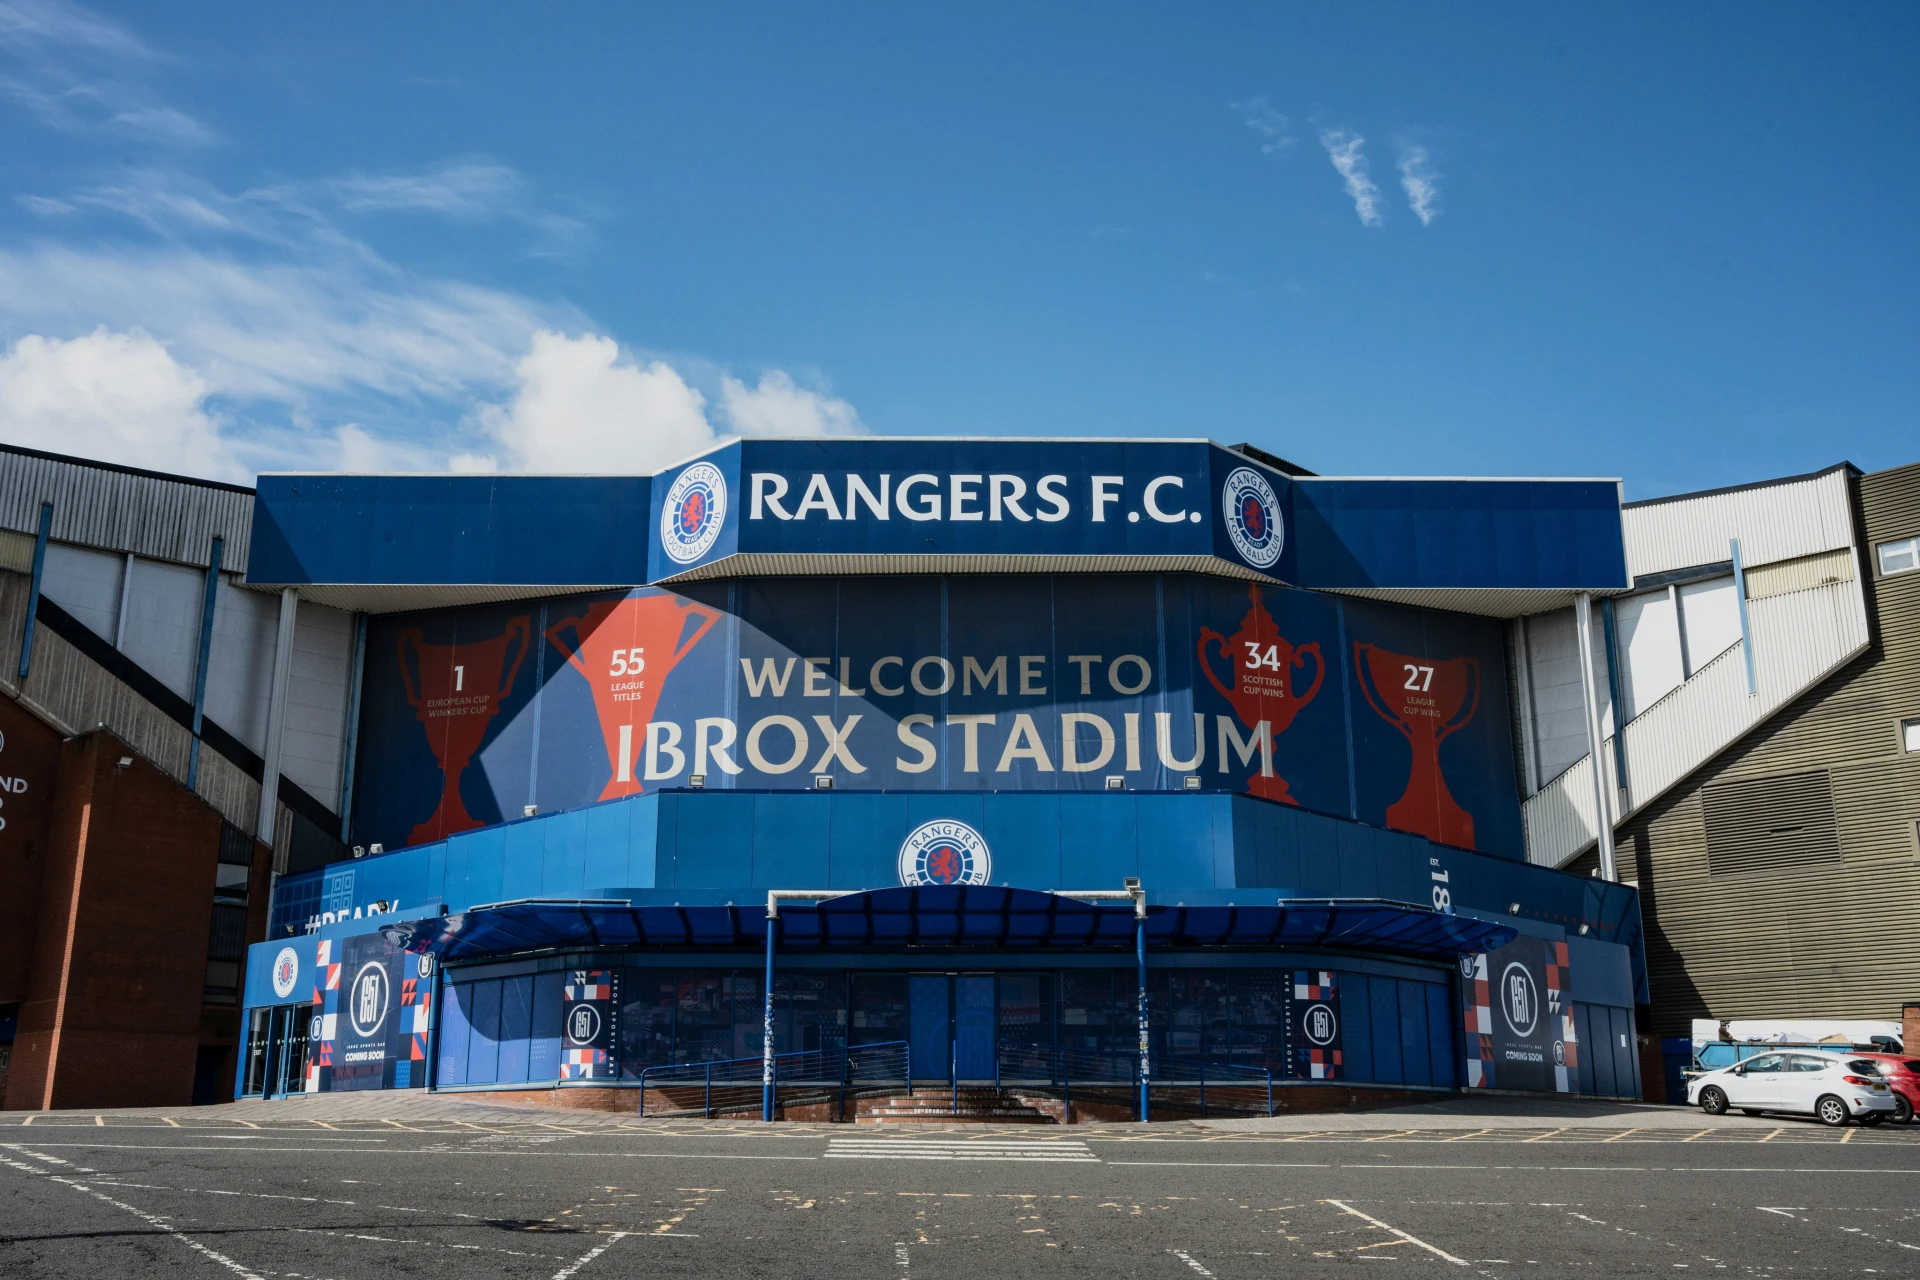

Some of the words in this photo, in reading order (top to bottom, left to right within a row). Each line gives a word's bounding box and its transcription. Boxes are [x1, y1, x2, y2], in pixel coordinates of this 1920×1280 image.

[671, 468, 719, 503] RANGERS
[749, 472, 1070, 522] RANGERS
[1090, 475, 1202, 523] F.C.
[1230, 473, 1276, 509] RANGERS
[666, 529, 704, 557] FOOTBALL
[703, 512, 721, 544] CLUB
[1229, 517, 1267, 561] FOOTBALL
[1266, 534, 1280, 559] CLUB
[1247, 537, 1263, 548] READY
[609, 647, 645, 677] 55
[1245, 641, 1281, 672] 34
[454, 665, 465, 692] 1
[611, 680, 645, 692] LEAGUE
[739, 654, 1048, 698] WELCOME
[1067, 654, 1152, 695] TO
[1242, 674, 1283, 687] SCOTTISH
[1403, 664, 1435, 692] 27
[427, 697, 472, 708] EUROPEAN
[472, 695, 490, 704] CUP
[613, 691, 642, 702] TITLES
[1243, 685, 1260, 695] CUP
[1261, 687, 1284, 698] WINS
[1406, 696, 1436, 707] LEAGUE
[470, 705, 487, 714] CUP
[1403, 706, 1419, 715] CUP
[1420, 708, 1441, 718] WINS
[616, 714, 868, 783] IBROX
[896, 711, 1275, 778] STADIUM
[910, 825, 980, 851] RANGERS
[345, 1051, 368, 1062] COMING
[368, 1050, 385, 1061] SOON
[1505, 1050, 1528, 1061] COMING
[1528, 1052, 1544, 1062] SOON
